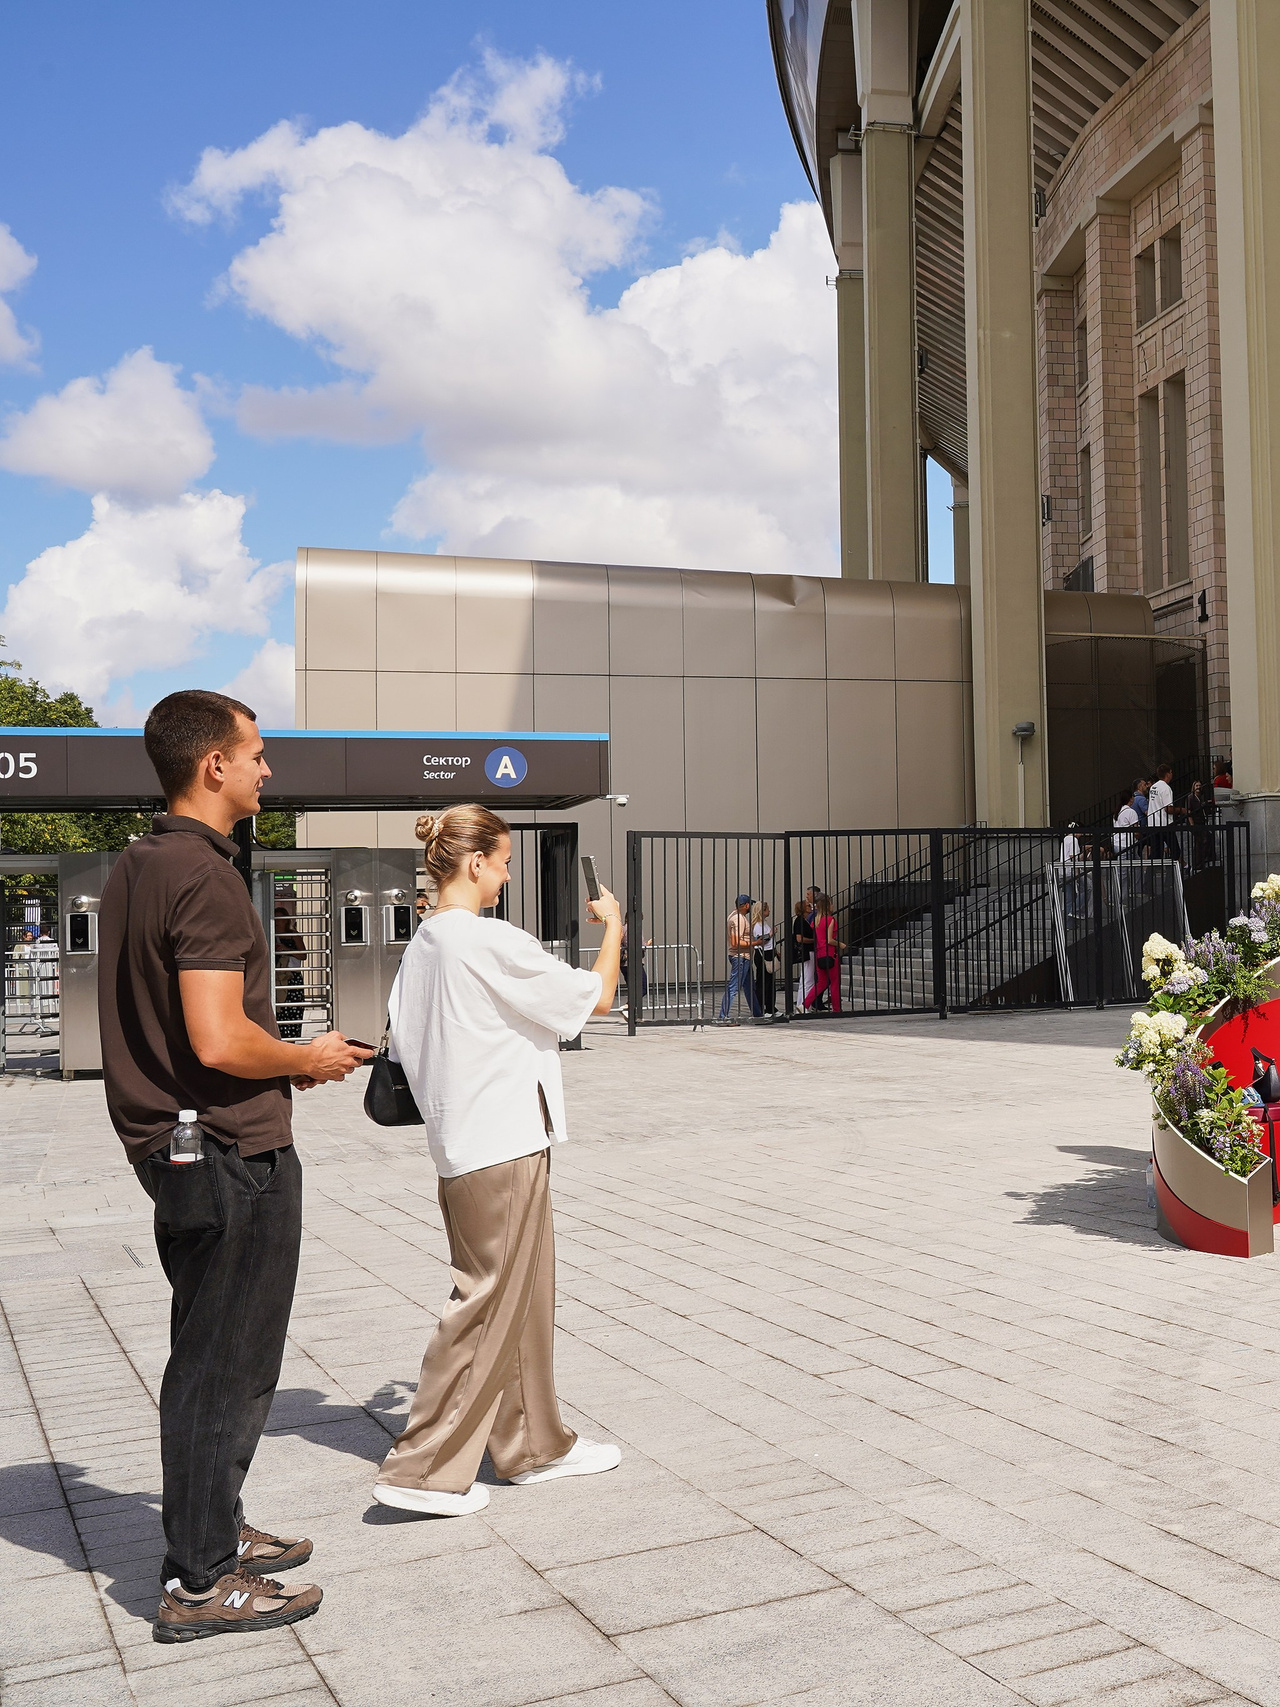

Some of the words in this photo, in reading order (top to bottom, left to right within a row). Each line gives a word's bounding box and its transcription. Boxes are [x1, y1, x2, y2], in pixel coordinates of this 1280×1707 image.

[422, 754, 471, 768] Сектор
[422, 770, 456, 780] Sector
[223, 1589, 251, 1609] N
